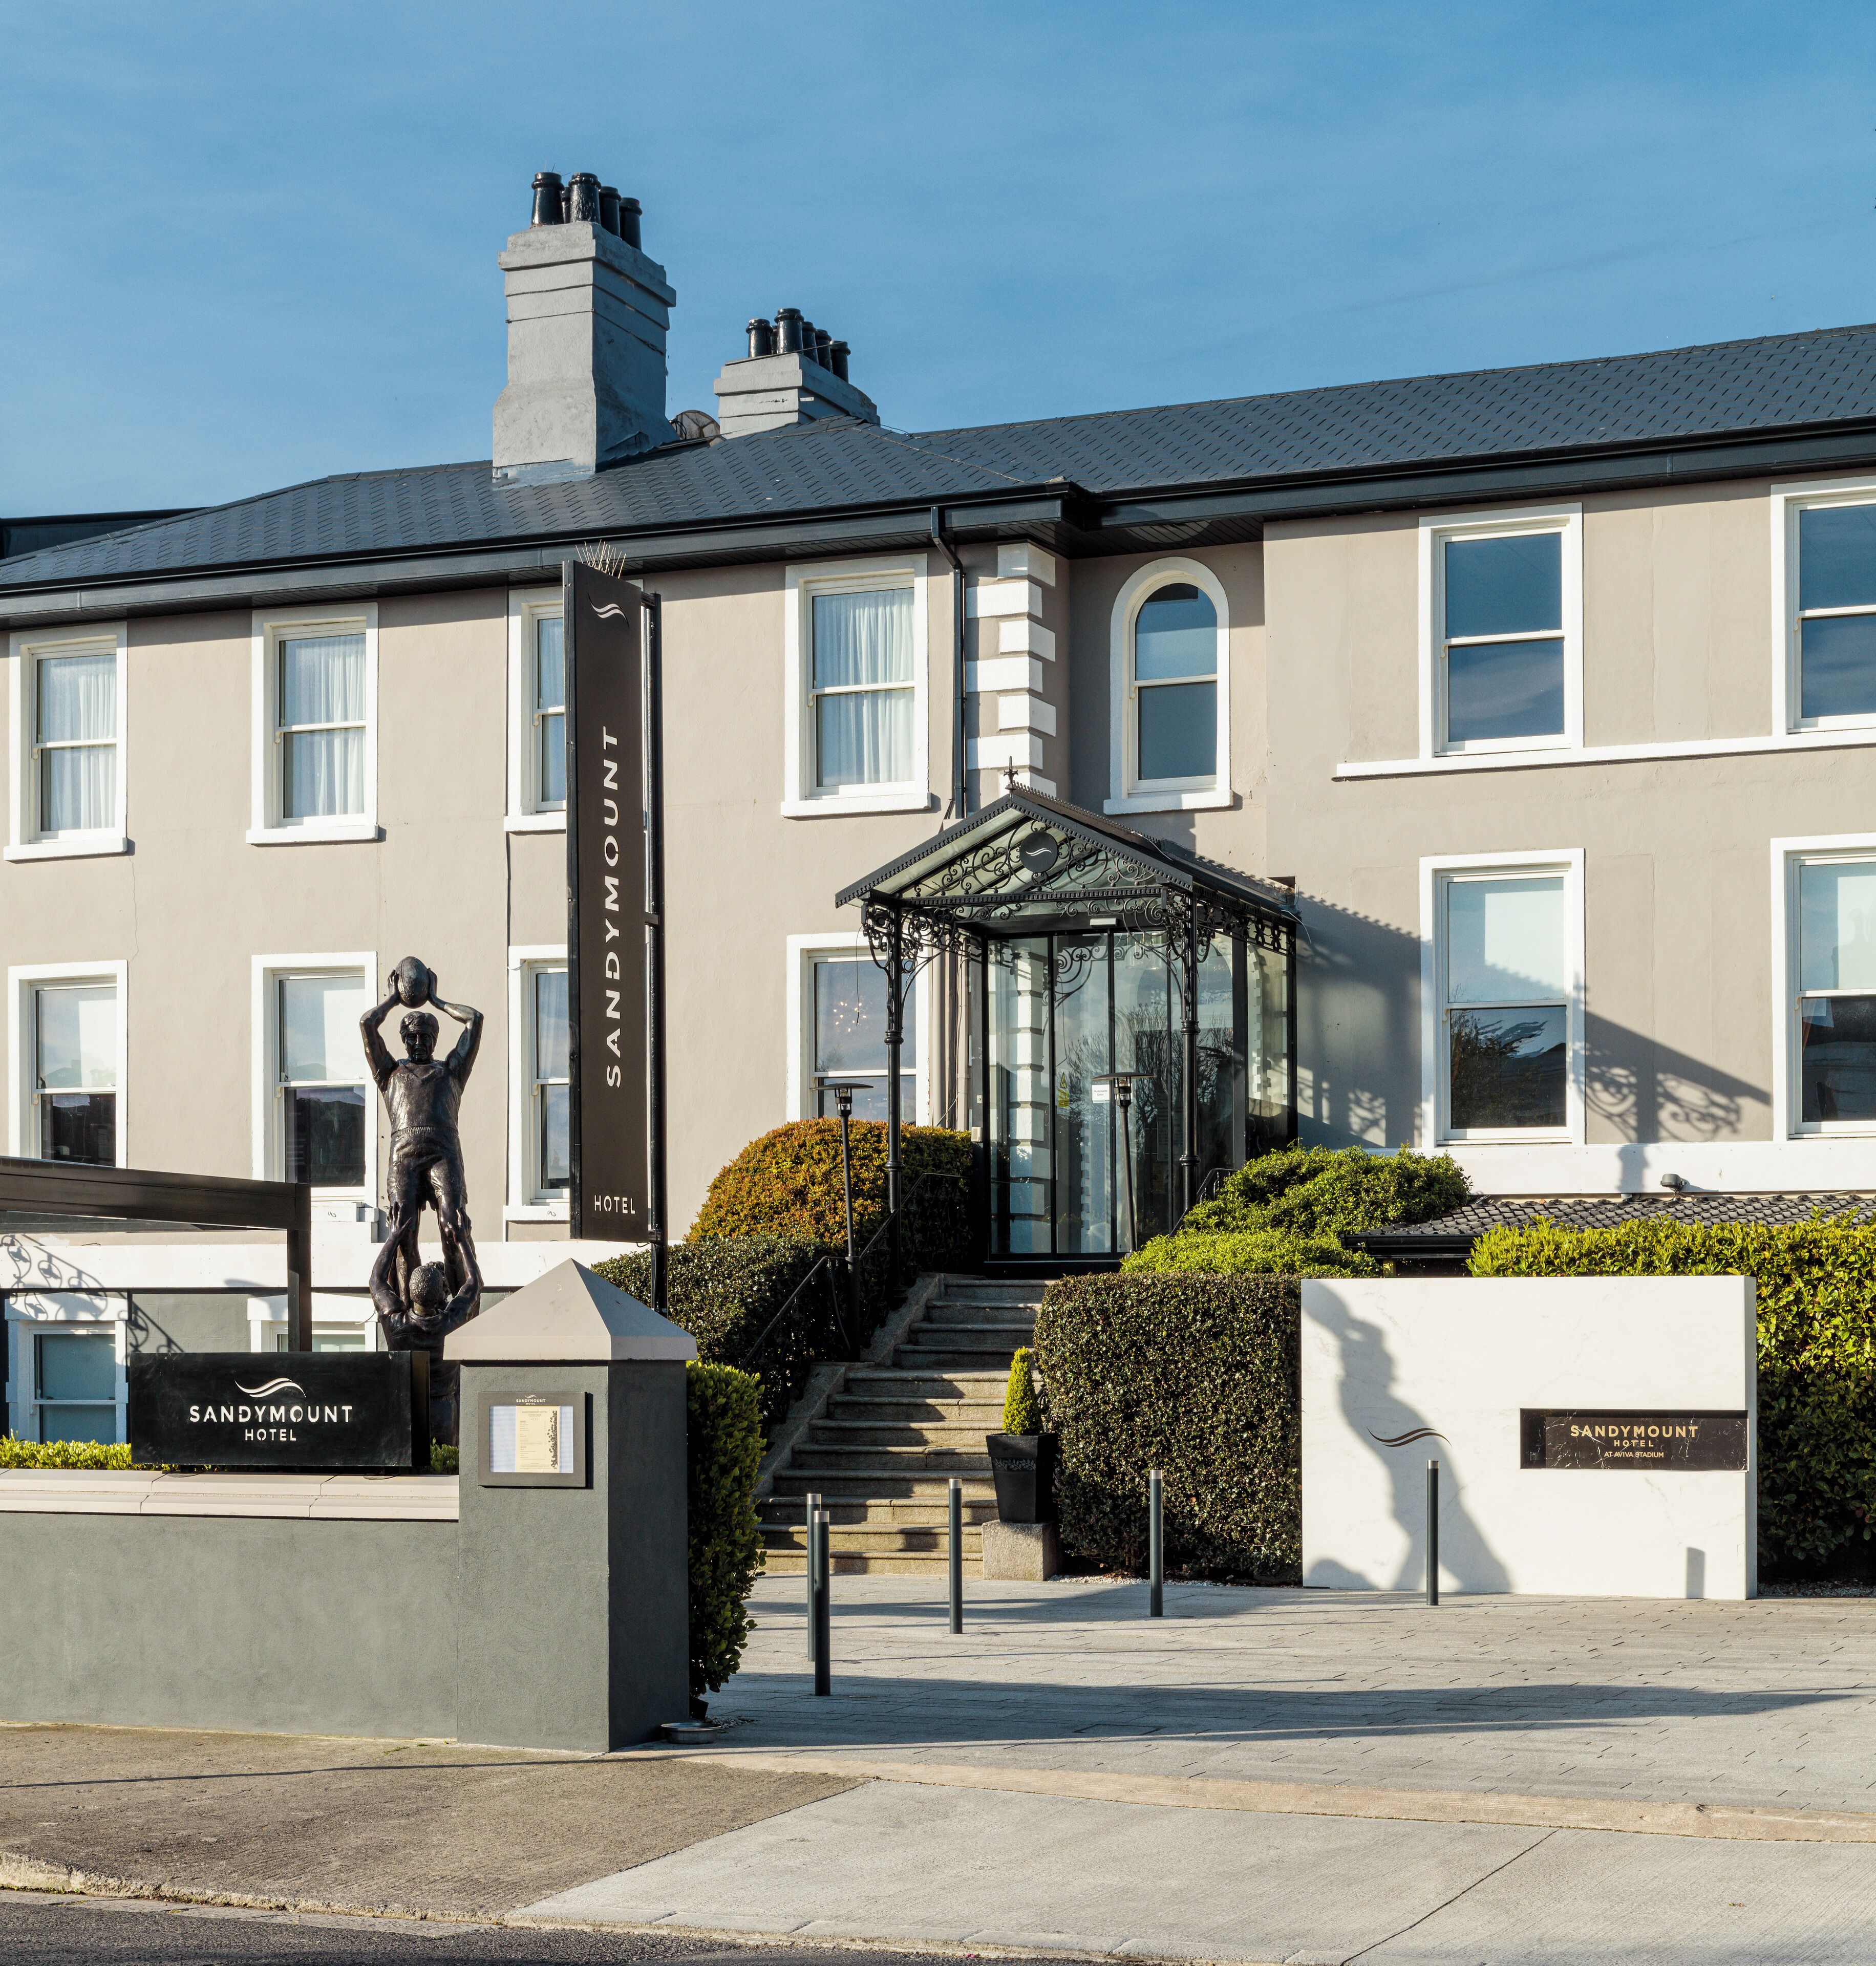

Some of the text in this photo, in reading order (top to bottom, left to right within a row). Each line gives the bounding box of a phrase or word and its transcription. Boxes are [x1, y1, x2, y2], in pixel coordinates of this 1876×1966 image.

[603, 725, 621, 1088] SANDYMOUNT
[594, 1194, 636, 1215] HOTEL
[189, 1405, 353, 1423] SANDYMOUNT
[245, 1428, 297, 1442] HOTEL
[1570, 1425, 1698, 1438] SANDYMOUNT
